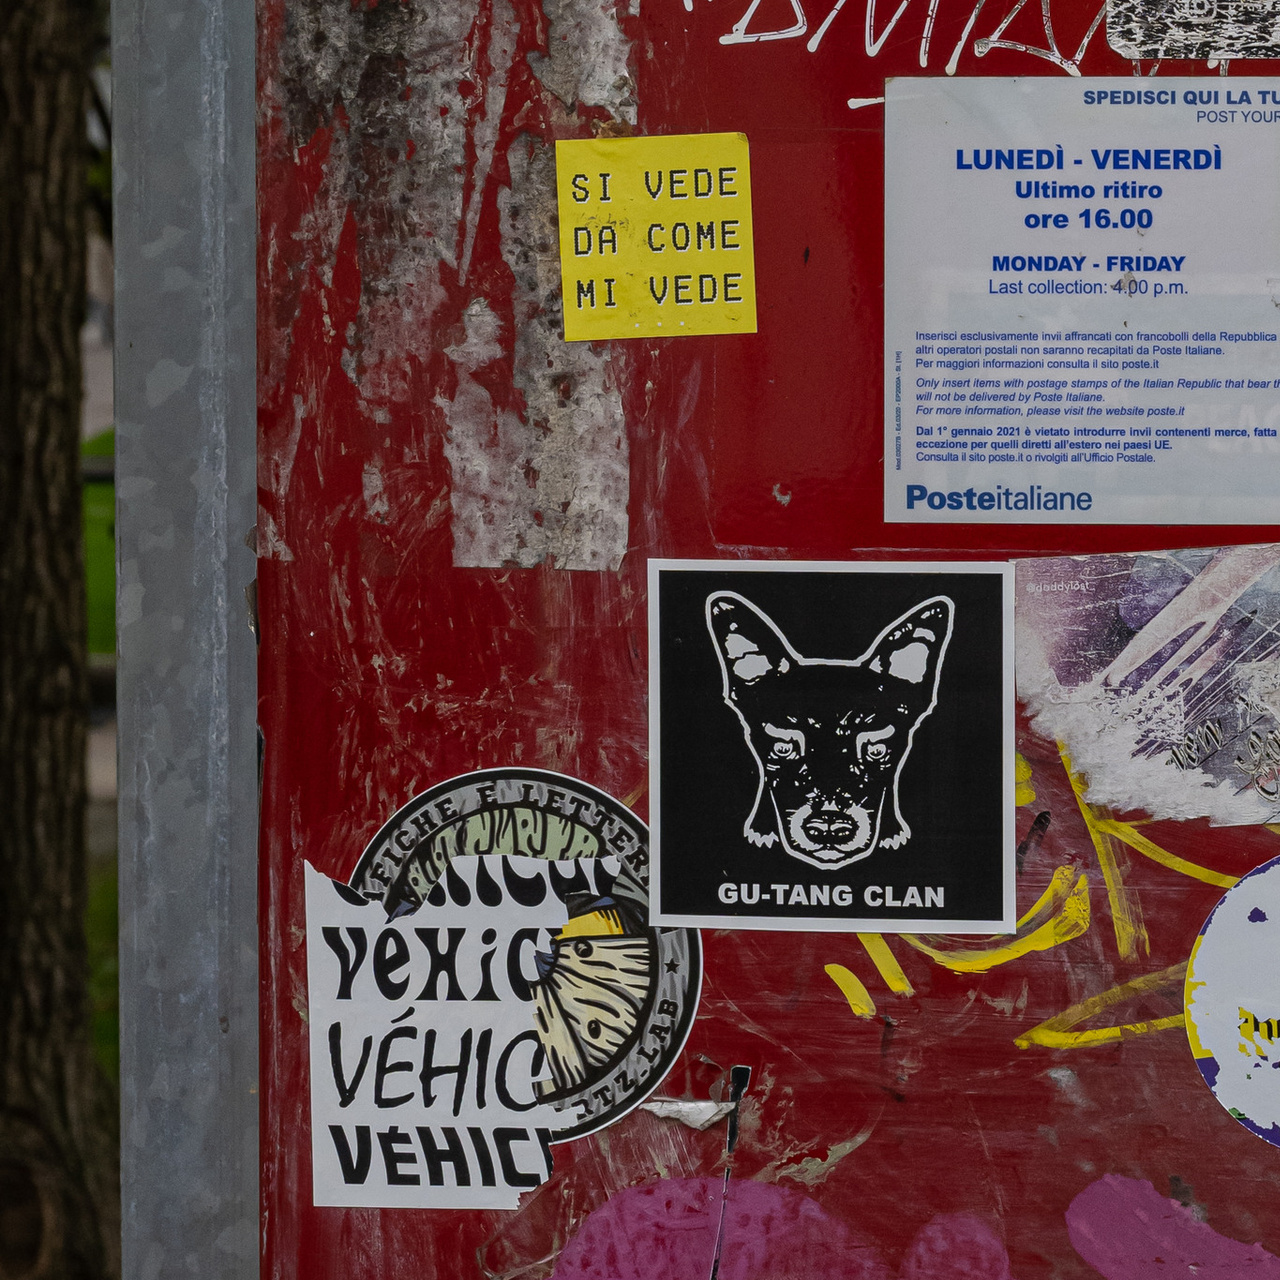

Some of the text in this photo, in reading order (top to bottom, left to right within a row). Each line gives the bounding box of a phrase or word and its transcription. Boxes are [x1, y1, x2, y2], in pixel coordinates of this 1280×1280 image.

[1084, 91, 1175, 104] SPEDISCI
[1183, 91, 1218, 105] QUI
[1227, 91, 1251, 104] LA
[1197, 111, 1237, 123] POST
[957, 144, 1063, 170] LUNEDÌ
[1091, 145, 1221, 169] VENERDÌ
[572, 167, 739, 203] SI VEDE
[1016, 181, 1162, 198] Ultimo ritiro
[1025, 209, 1152, 228] ore 16.00
[574, 220, 741, 257] DA COME
[993, 256, 1086, 271] MONDAY
[1107, 256, 1186, 271] FRIDAY
[577, 273, 743, 309] MI VEDE
[990, 279, 1187, 297] Last collection: 4.00 p.m.
[916, 345, 933, 354] altri
[937, 345, 981, 356] operatori
[985, 345, 1017, 356] postali
[1087, 346, 1133, 356] recapitati
[1137, 346, 1149, 355] da
[1153, 345, 1182, 355] Poste
[1186, 346, 1224, 355] Italiane.
[916, 359, 1159, 370] Per maggiori informazioni consulta il sito poste.it
[916, 392, 1104, 403] will not be delivered by Poste Italiane.
[916, 405, 933, 415] For
[965, 406, 1023, 416] information,
[1027, 406, 1060, 417] please
[1064, 407, 1084, 415] visit
[1087, 407, 1102, 415] the
[1106, 406, 1144, 415] website
[1147, 407, 1185, 417] poste.it
[917, 426, 933, 435] Dal
[938, 427, 947, 435] 1°
[951, 427, 992, 438] gennaio
[997, 427, 1019, 436] 2021
[1025, 427, 1031, 436] è
[1035, 427, 1070, 436] vietato
[1074, 427, 1125, 436] introdurre
[1130, 427, 1151, 436] invii
[1156, 427, 1210, 436] contenenti
[1254, 427, 1277, 436] fatta
[916, 440, 968, 448] eccezione
[971, 442, 988, 450] per
[991, 440, 1018, 450] quelli
[1022, 440, 1051, 449] diretti
[1105, 440, 1120, 449] nei
[1124, 440, 1151, 451] paesi
[1155, 440, 1172, 449] UE.
[907, 485, 1092, 510] Posteitaliane
[476, 781, 499, 808] E
[718, 883, 945, 908] GU-TANG CLAN
